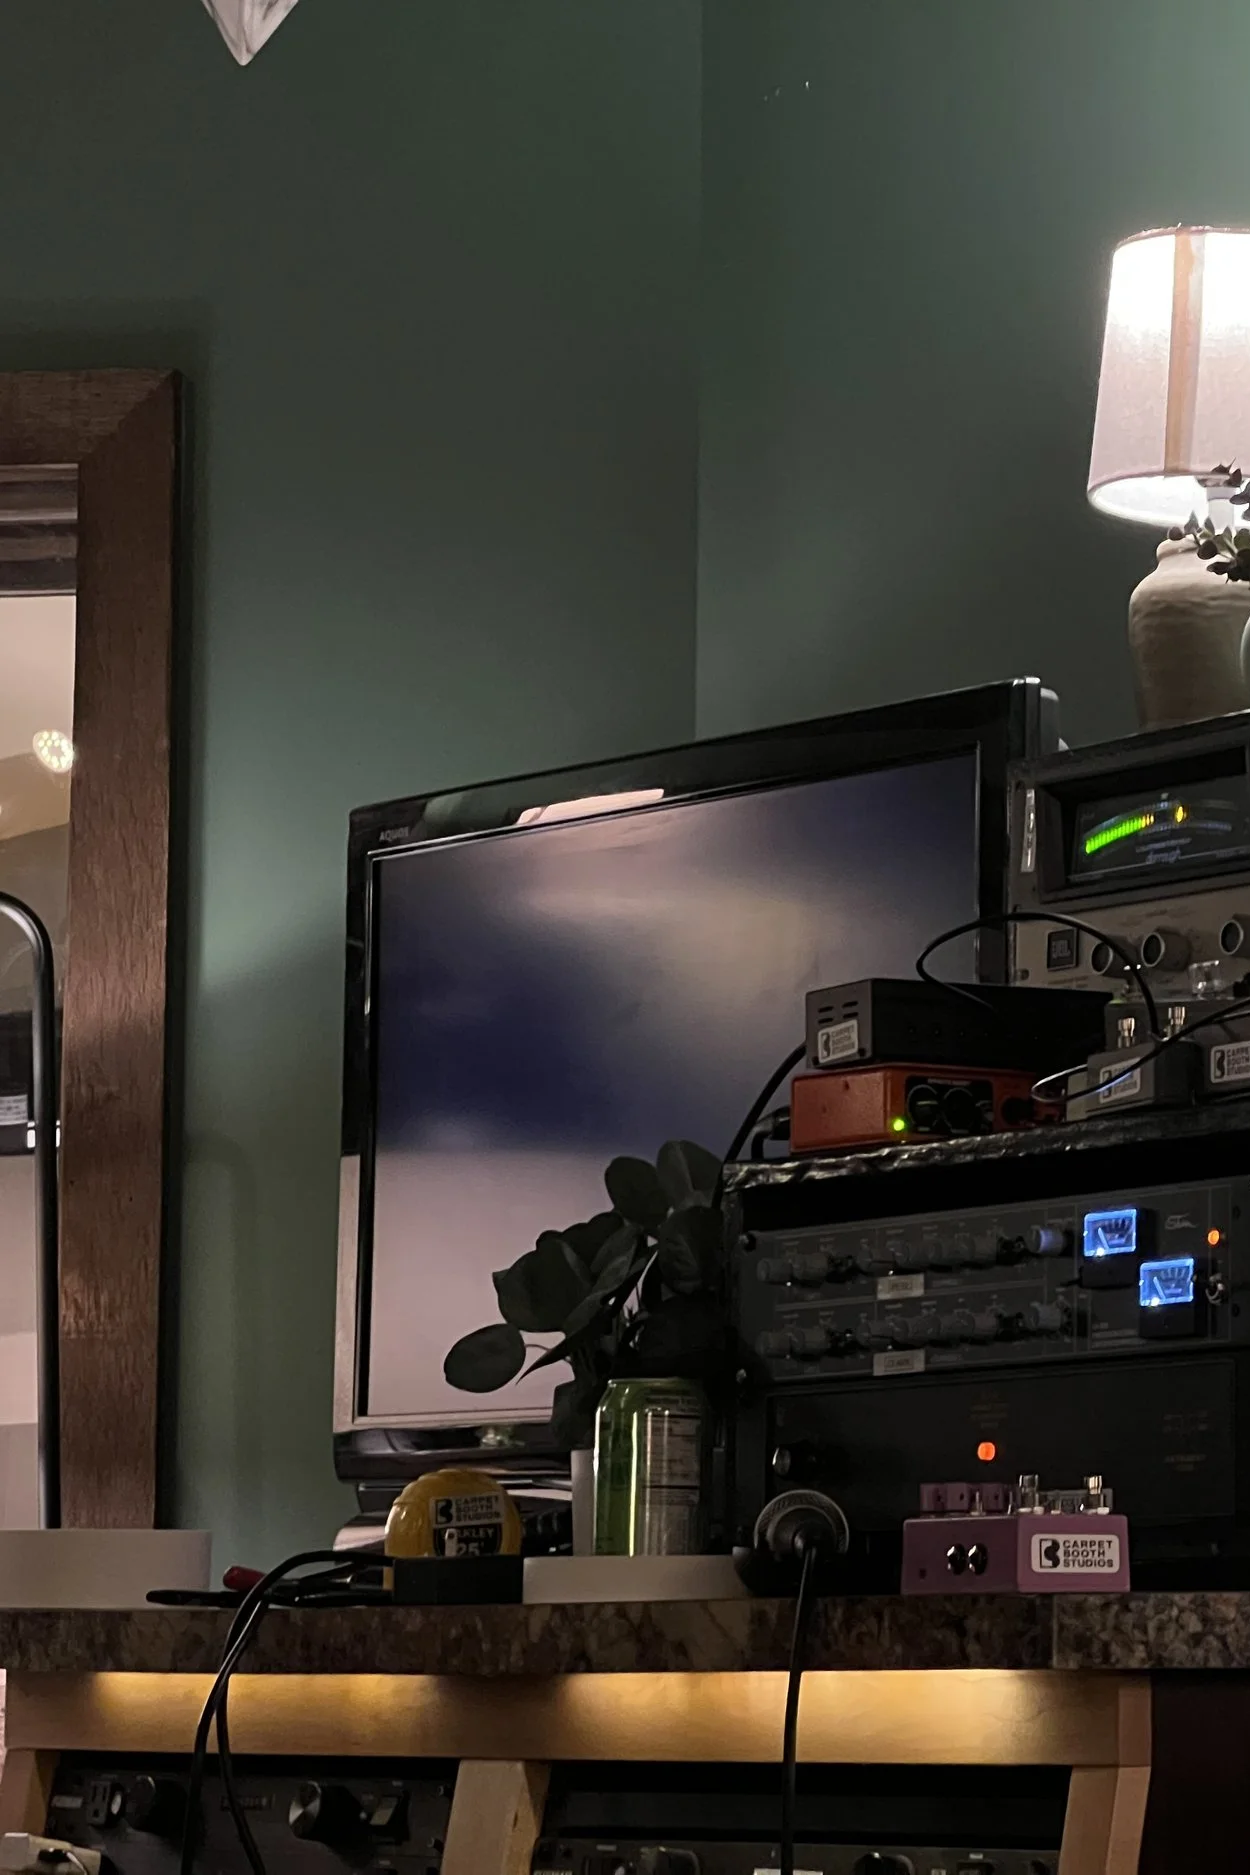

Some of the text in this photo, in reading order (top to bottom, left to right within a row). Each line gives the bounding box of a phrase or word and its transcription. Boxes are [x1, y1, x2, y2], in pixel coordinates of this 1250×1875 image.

[455, 1495, 499, 1506] CARPET
[455, 1504, 493, 1513] BOOTH
[455, 1511, 501, 1522] STUDIOS
[1063, 1540, 1113, 1549] CARPET
[1063, 1549, 1105, 1558] BOOTH
[1063, 1559, 1114, 1568] STUDIOS
